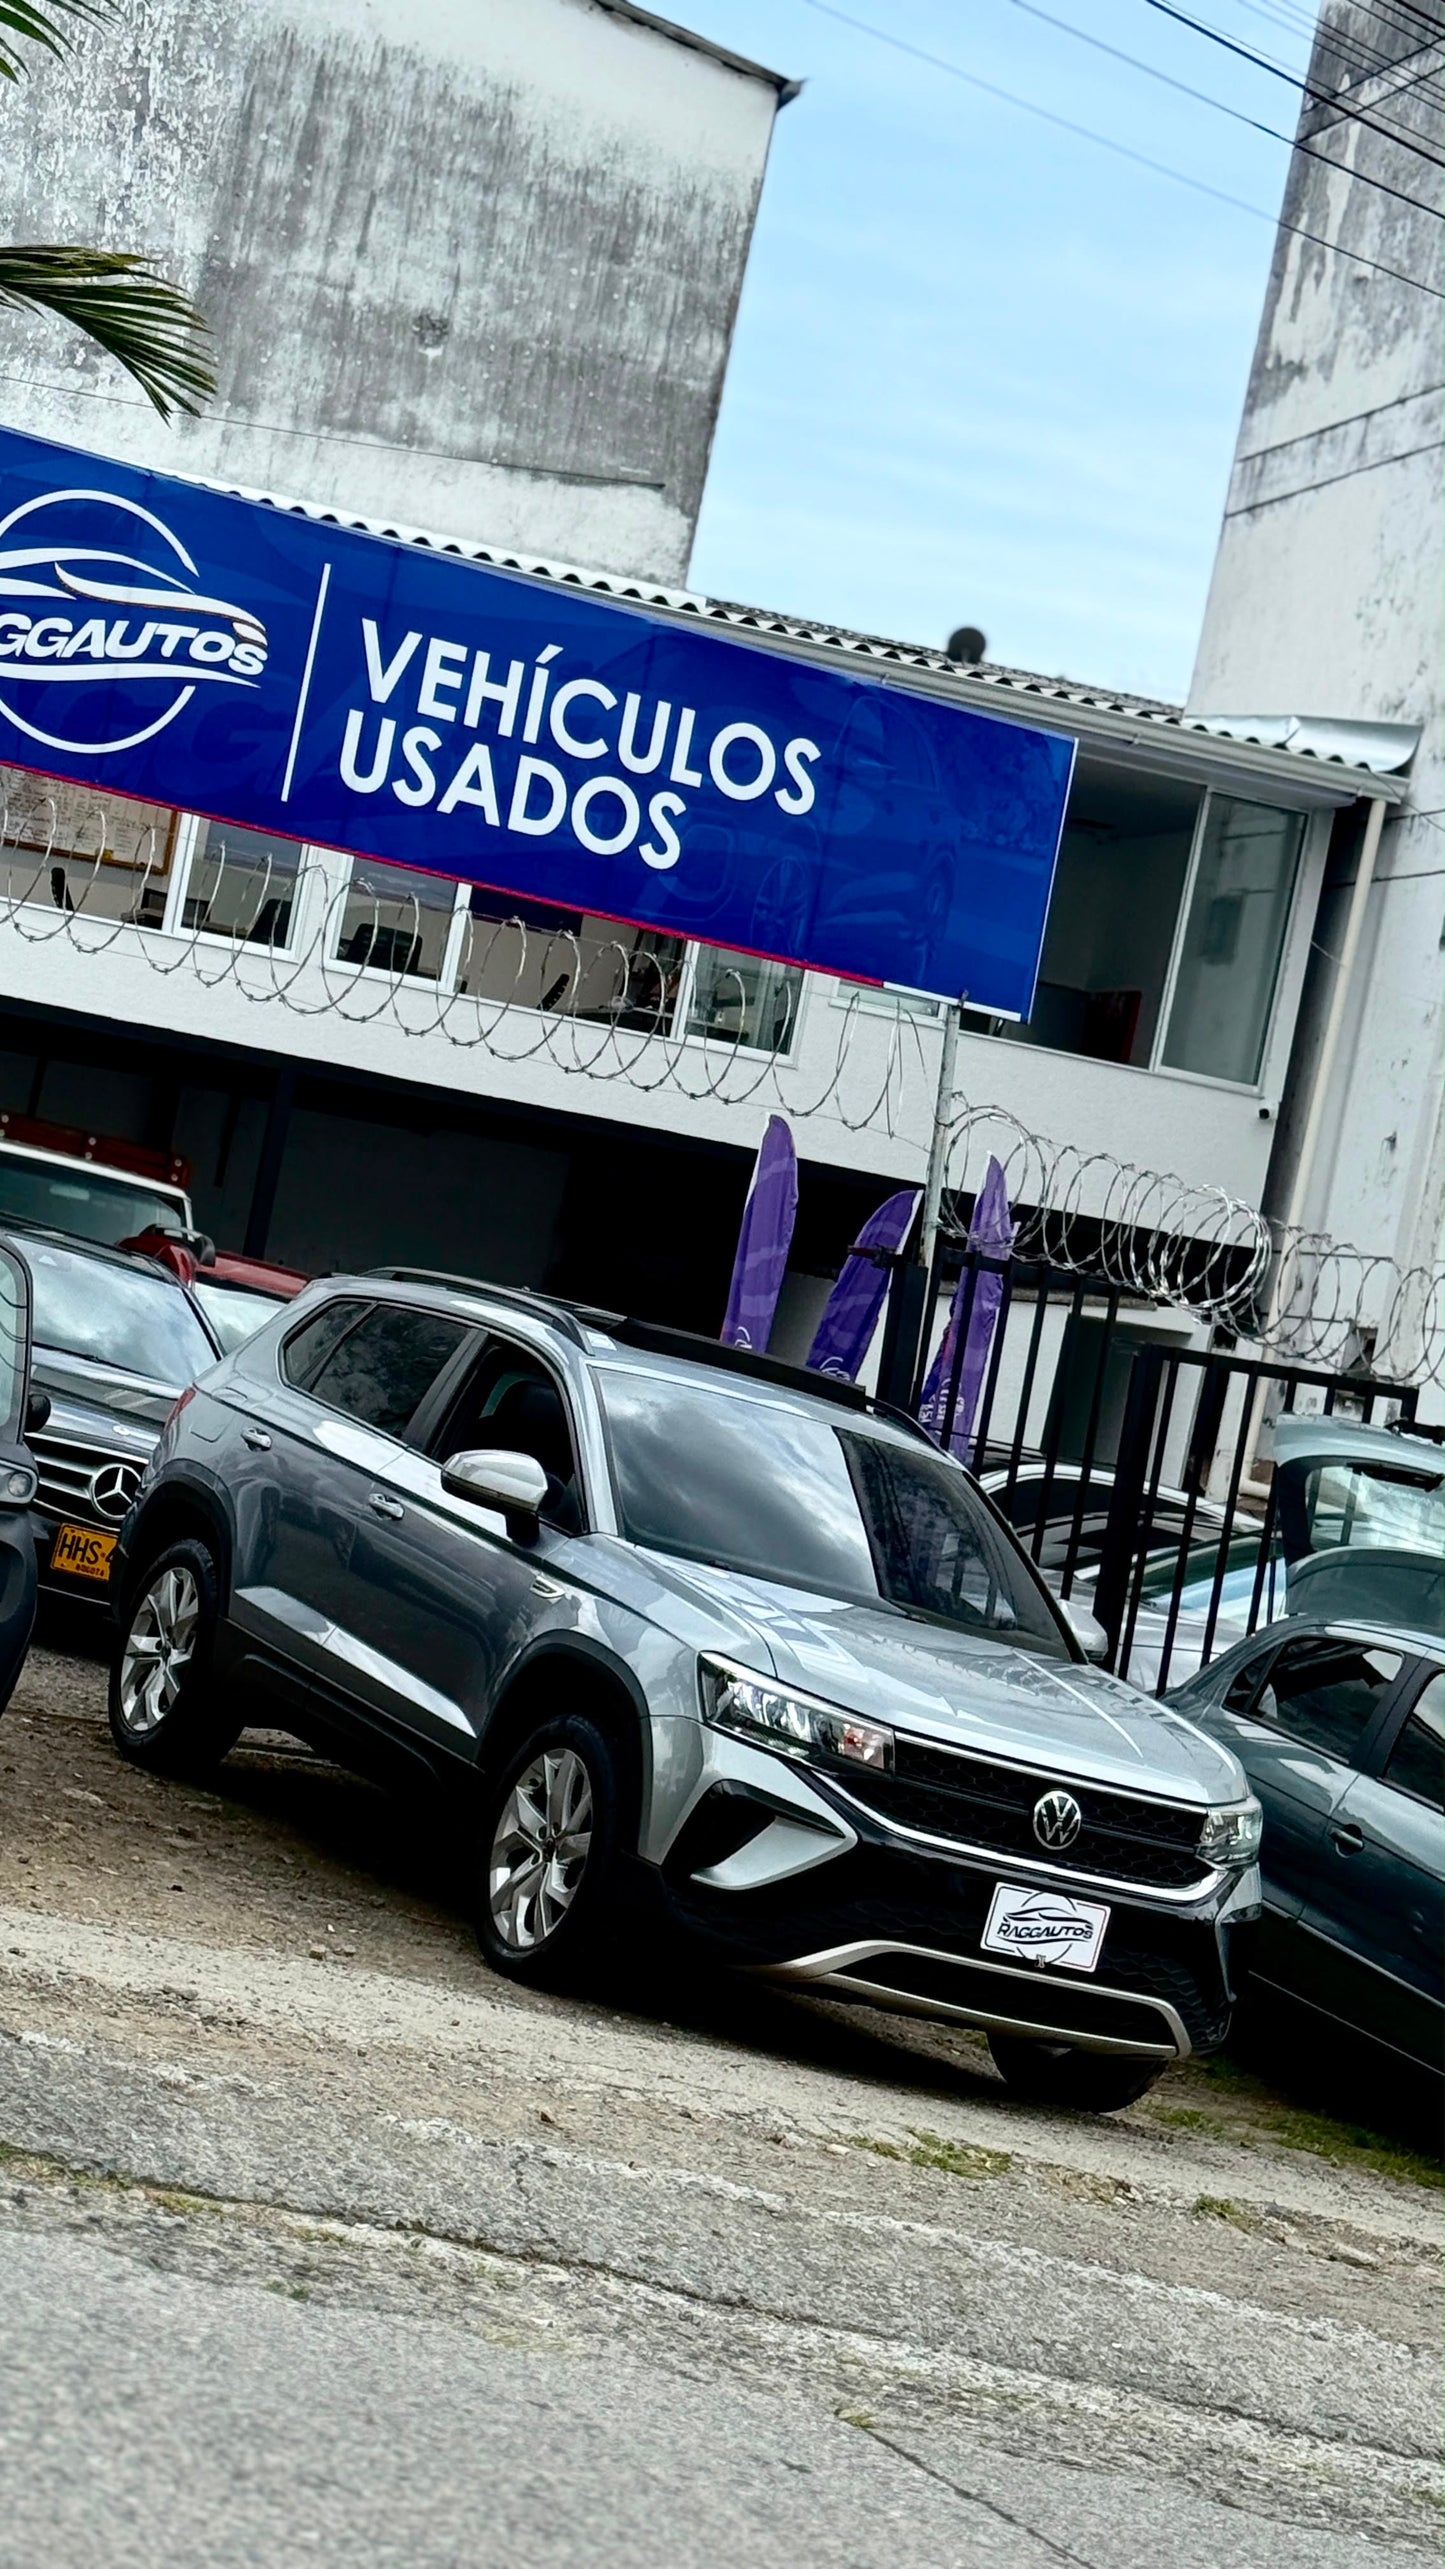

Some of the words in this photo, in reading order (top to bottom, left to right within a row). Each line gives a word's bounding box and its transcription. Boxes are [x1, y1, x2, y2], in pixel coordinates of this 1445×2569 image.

[339, 708, 687, 870] USADOS
[361, 619, 821, 816] VEHÍCULOS
[997, 1922, 1093, 1939] RAGGAUTOS
